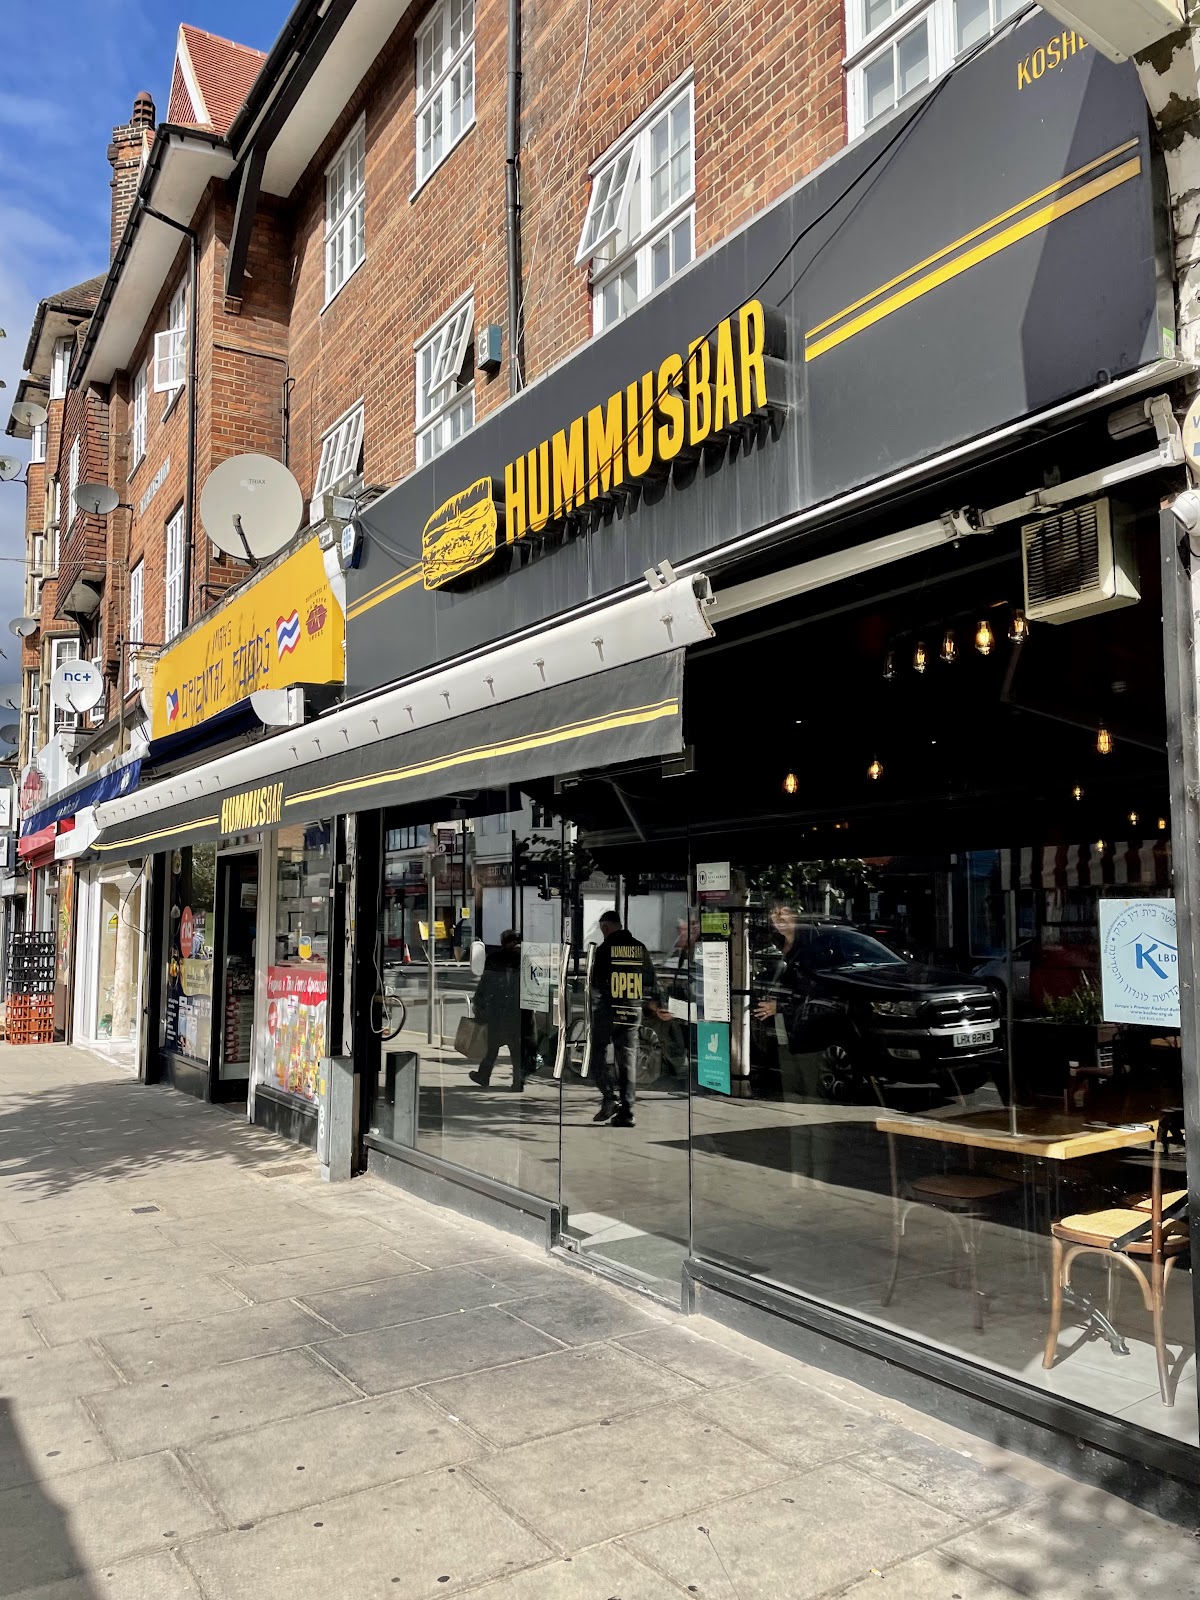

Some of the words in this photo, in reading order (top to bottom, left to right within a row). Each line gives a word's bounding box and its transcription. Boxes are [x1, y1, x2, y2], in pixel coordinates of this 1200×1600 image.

[504, 299, 768, 546] HUMMUSBAR
[64, 672, 92, 682] nc+
[182, 658, 226, 718] ORIENTAL
[233, 628, 271, 686] FOODS
[221, 783, 283, 834] HUMMUSBAR
[181, 921, 192, 940] ria
[1135, 943, 1169, 980] K
[1158, 953, 1177, 963] LBD
[611, 971, 643, 1000] OPEN
